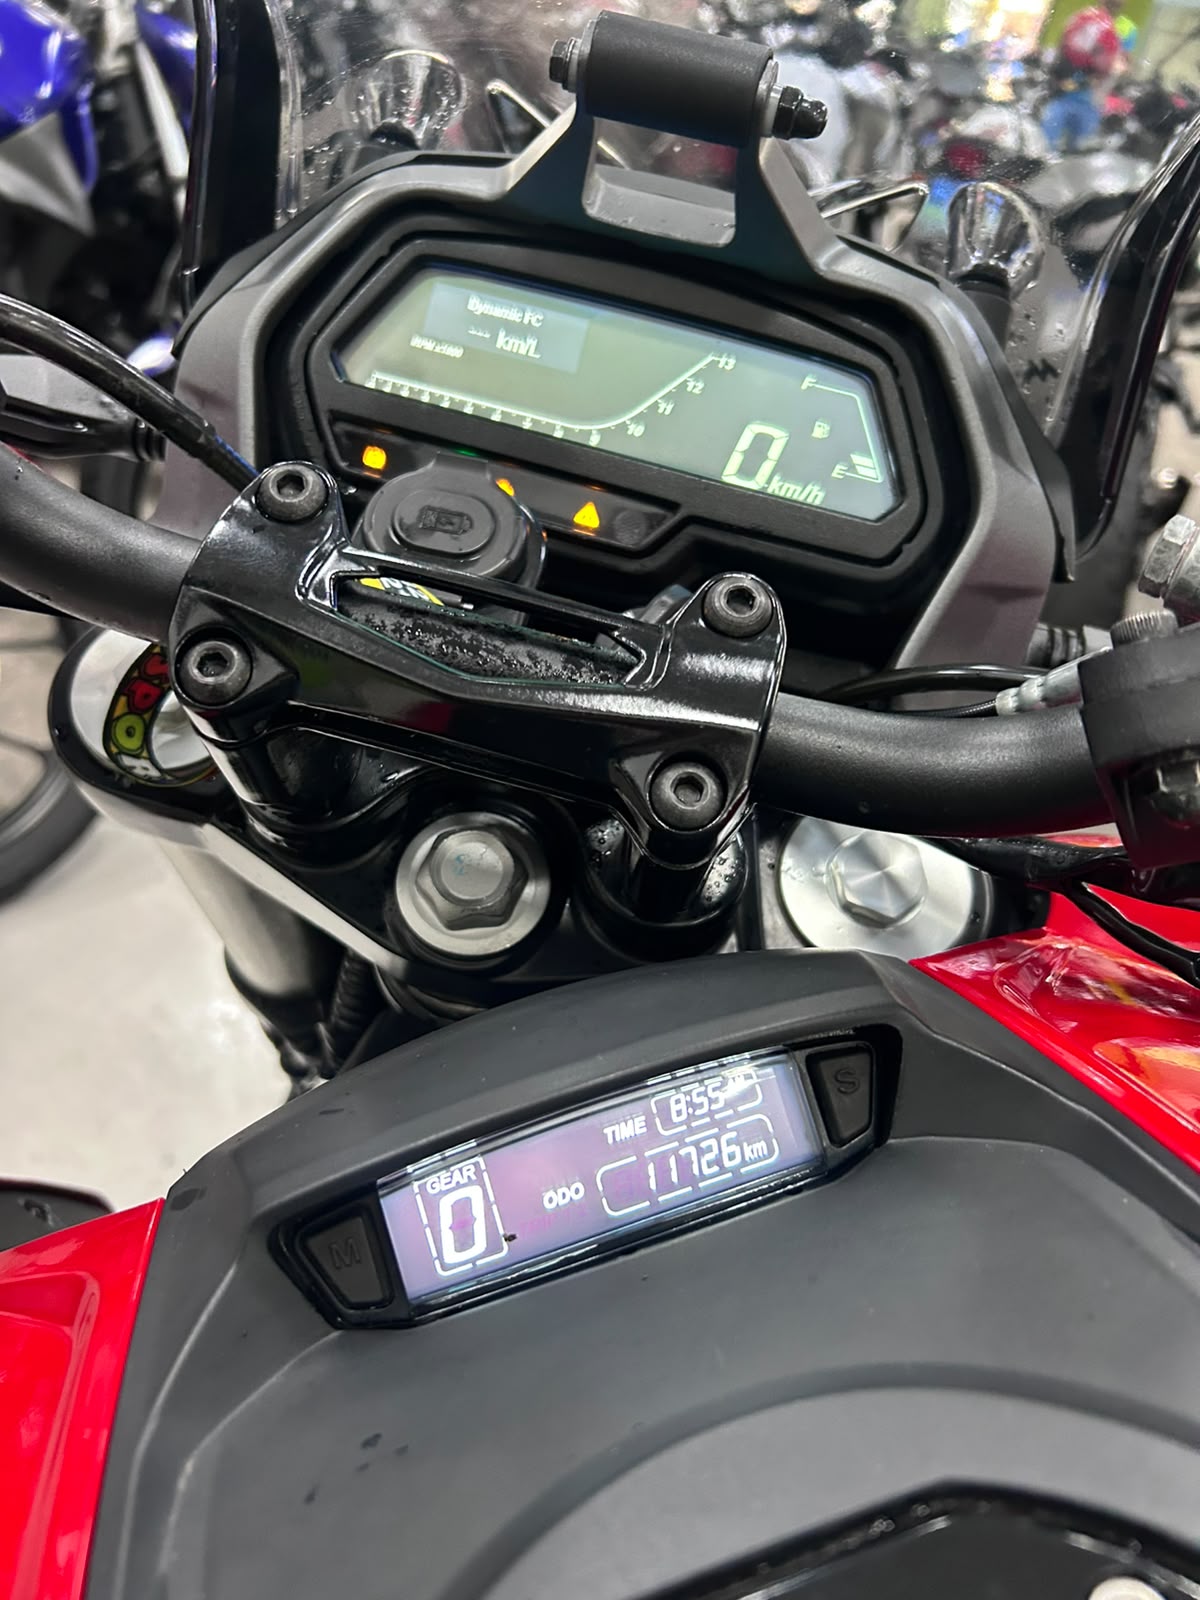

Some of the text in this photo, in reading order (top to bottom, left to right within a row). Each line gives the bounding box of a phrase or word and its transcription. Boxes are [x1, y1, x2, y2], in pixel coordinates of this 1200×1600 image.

[717, 353, 736, 371] 13
[686, 377, 704, 393] 12
[801, 374, 815, 390] F
[657, 401, 675, 415] 11
[627, 421, 645, 437] 10
[721, 421, 826, 505] 0 km/h
[831, 464, 847, 479] E
[834, 1067, 860, 1095] S
[603, 1115, 647, 1145] TIME
[670, 1081, 725, 1123] 8:55
[426, 1163, 477, 1194] GEAR
[542, 1131, 768, 1210] ODO 11726 km
[439, 1185, 487, 1264] 0
[328, 1237, 362, 1270] M
